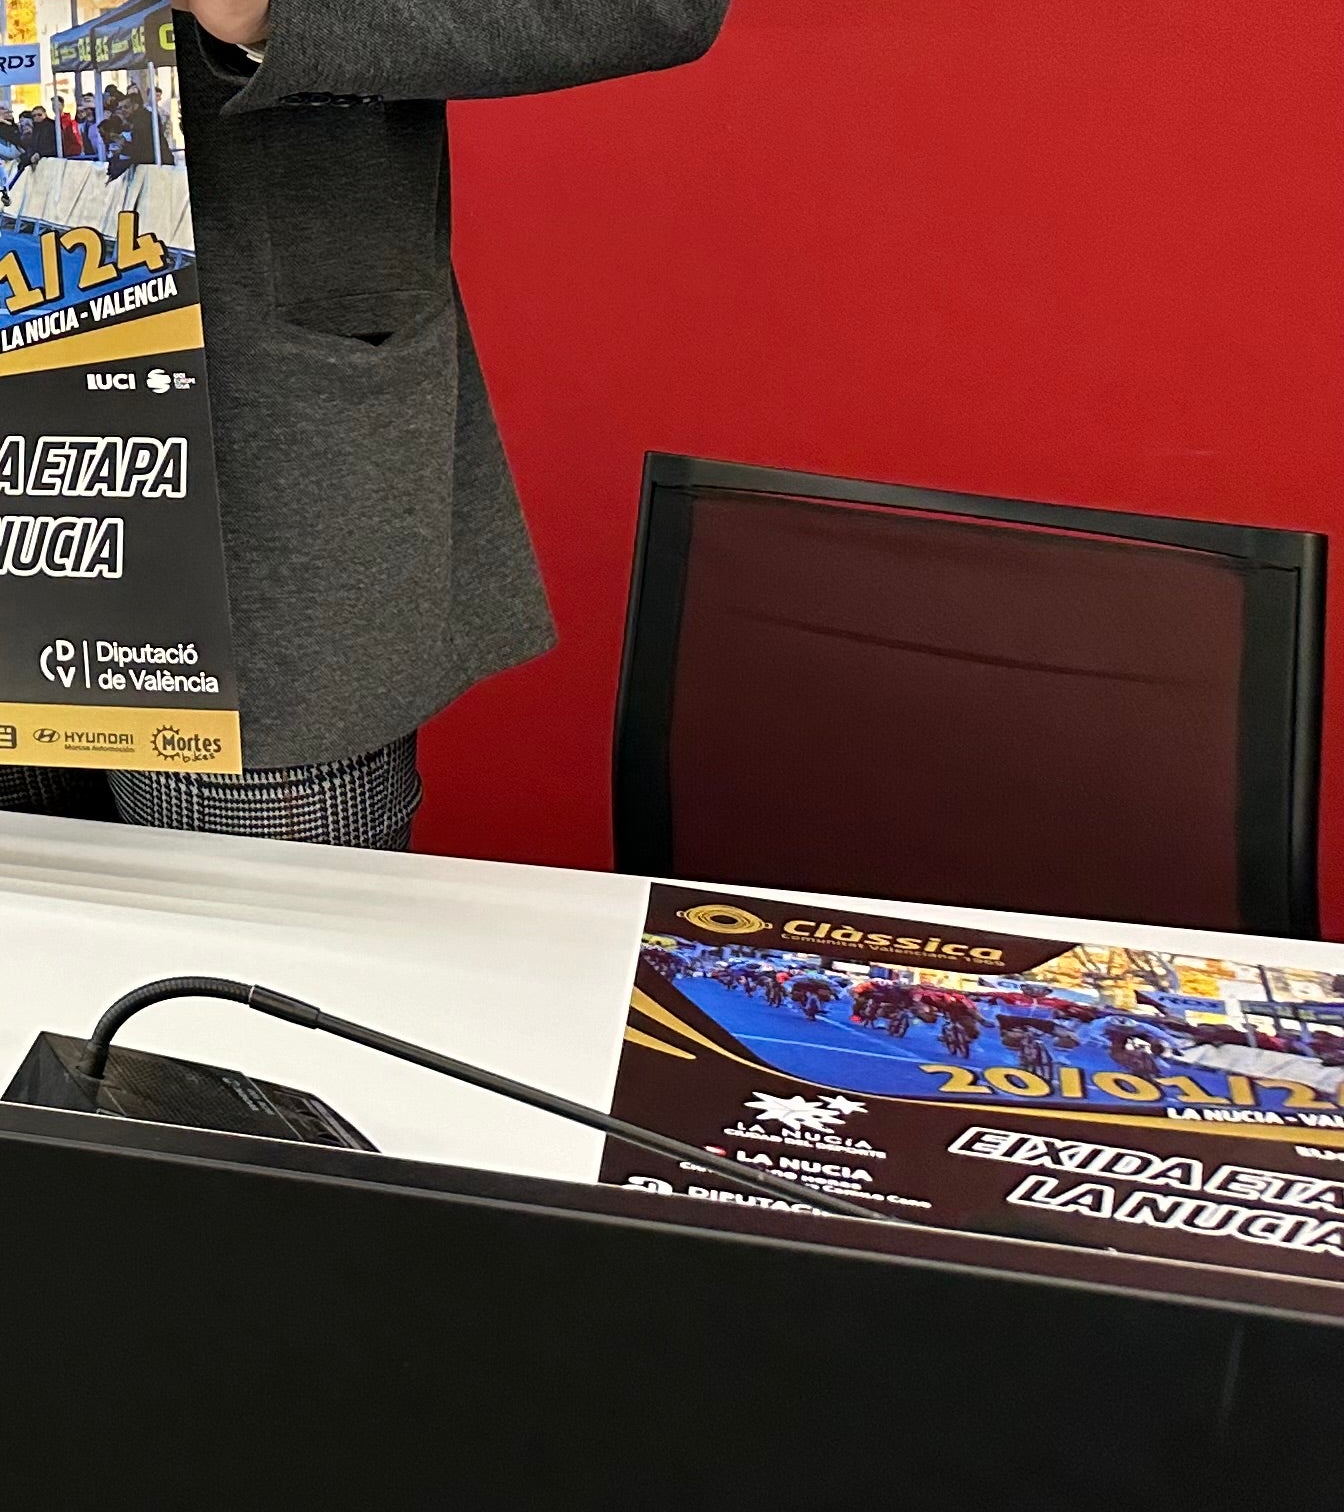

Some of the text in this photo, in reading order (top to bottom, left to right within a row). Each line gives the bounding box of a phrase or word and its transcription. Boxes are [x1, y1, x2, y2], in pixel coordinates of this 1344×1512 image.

[1, 273, 178, 353] LA NUCIA VALENCIA
[25, 436, 188, 498] ETAPA
[96, 641, 199, 668] Diputació
[97, 668, 220, 694] de València
[64, 731, 134, 745] HYUNDAI
[162, 733, 222, 754] Mortes
[783, 919, 1004, 962] Clàssica
[919, 1063, 1344, 1110] 20/01/2
[737, 1121, 766, 1132] LA
[1166, 1106, 1285, 1125] LA NUCIA
[736, 1149, 774, 1166] LA
[778, 1156, 874, 1182] NUCIA
[947, 1126, 1204, 1191] EIXIDA
[1007, 1173, 1344, 1256] LA NUCIA
